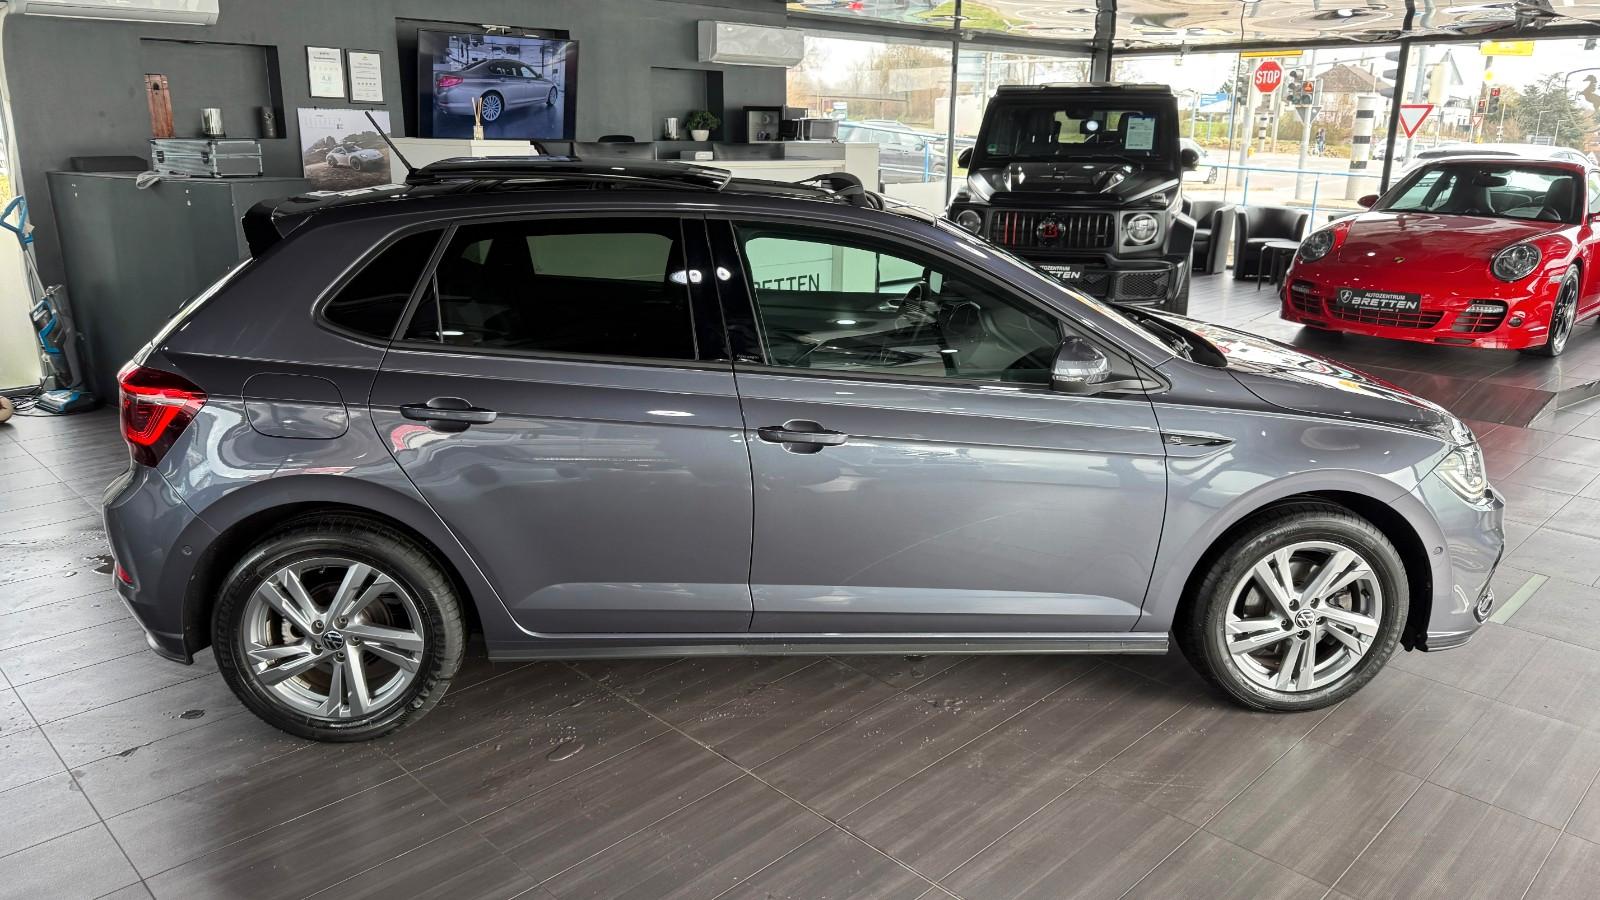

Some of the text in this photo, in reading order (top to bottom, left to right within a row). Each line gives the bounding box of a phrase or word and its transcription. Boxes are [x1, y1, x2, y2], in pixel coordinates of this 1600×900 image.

[1256, 70, 1280, 84] STOP
[1365, 292, 1406, 300] AUTOZENTRUM
[1351, 297, 1418, 310] BRETTEN
